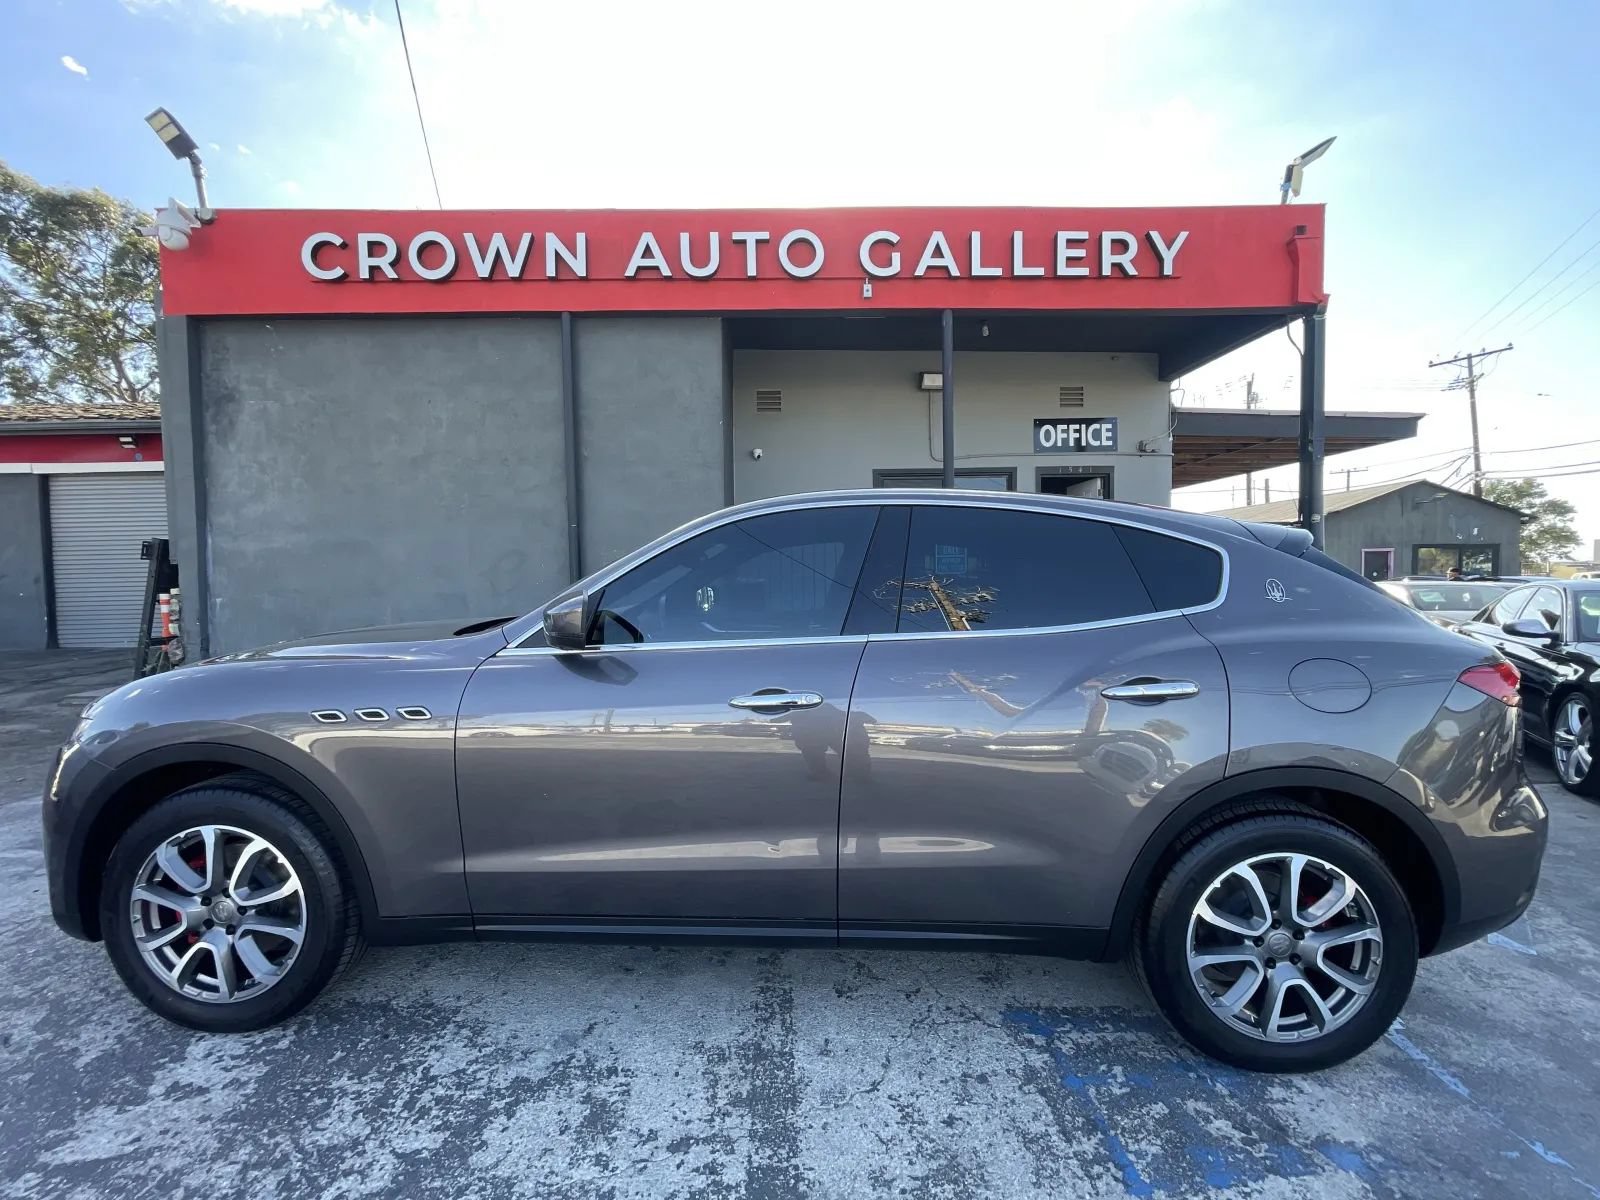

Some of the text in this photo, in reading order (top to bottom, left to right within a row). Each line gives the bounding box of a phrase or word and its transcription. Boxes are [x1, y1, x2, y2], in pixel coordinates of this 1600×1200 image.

[300, 229, 1190, 283] CROWN AUTO GALLERY
[1039, 423, 1113, 447] OFFICE
